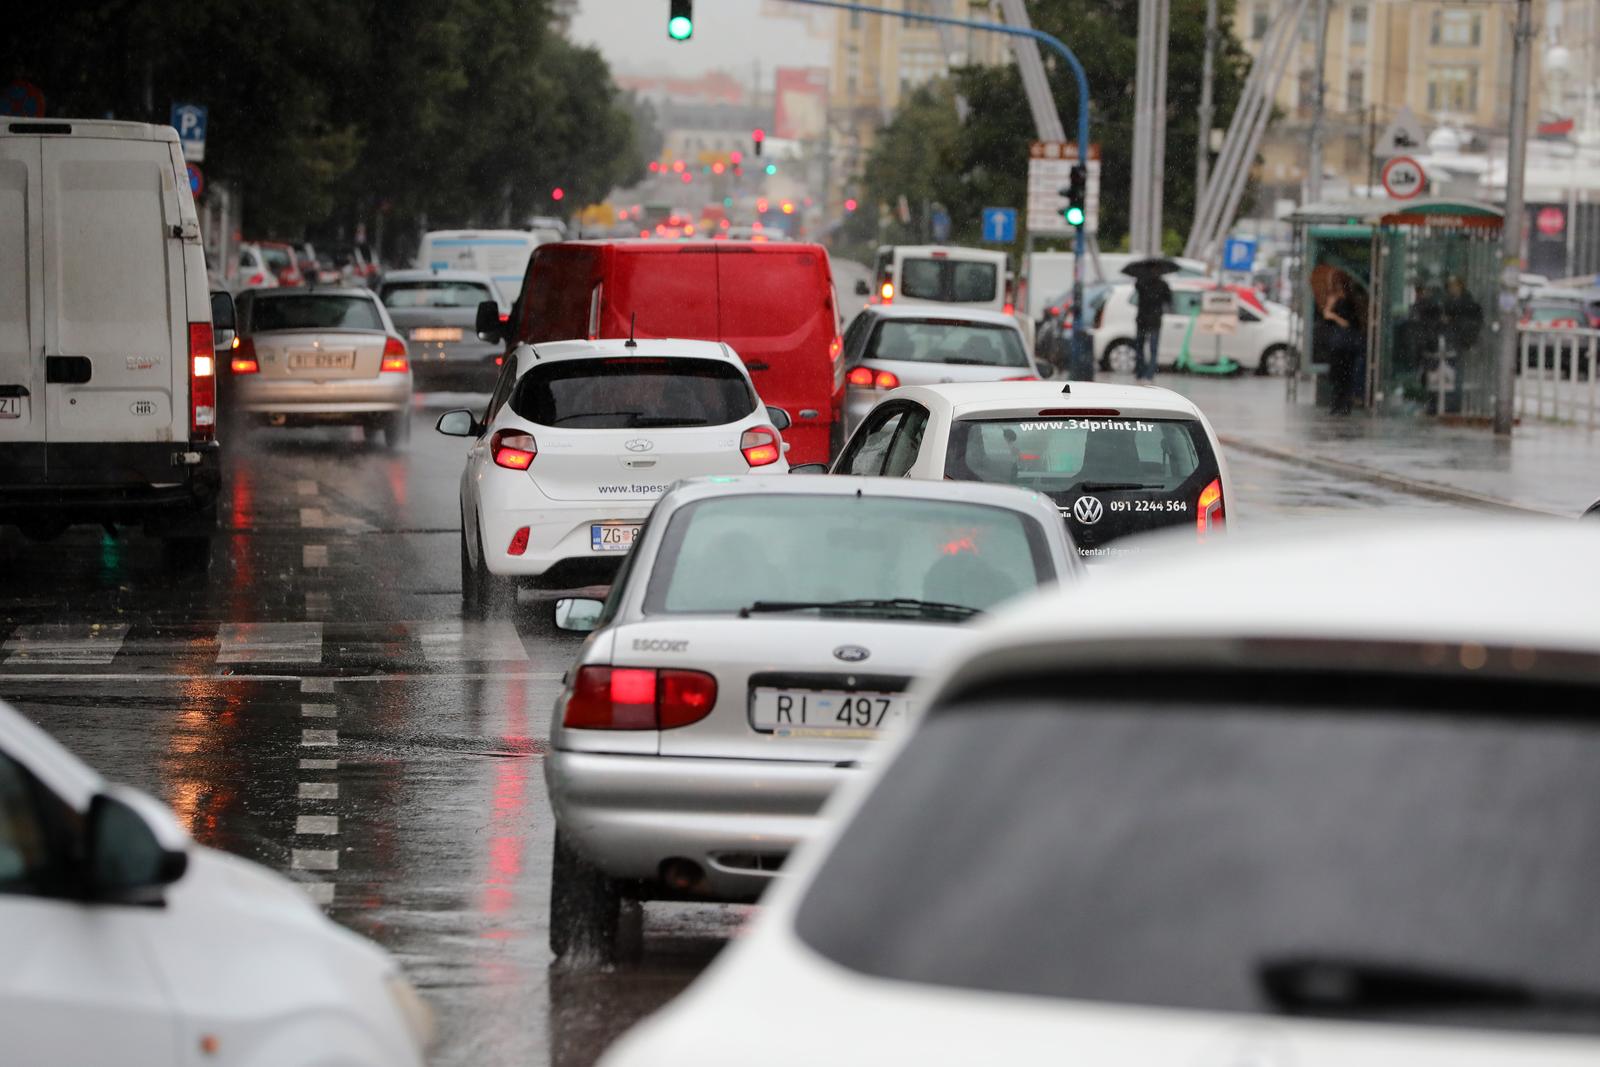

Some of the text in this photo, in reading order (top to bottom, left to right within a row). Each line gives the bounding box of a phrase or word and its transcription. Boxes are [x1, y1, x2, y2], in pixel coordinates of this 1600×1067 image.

[181, 112, 198, 136] P
[136, 406, 151, 414] HR
[1020, 419, 1154, 432] www.3dprint.hr
[1110, 500, 1187, 511] 091 2244 564
[603, 528, 621, 543] ZG
[632, 638, 689, 651] ESCORT
[778, 696, 807, 723] RI
